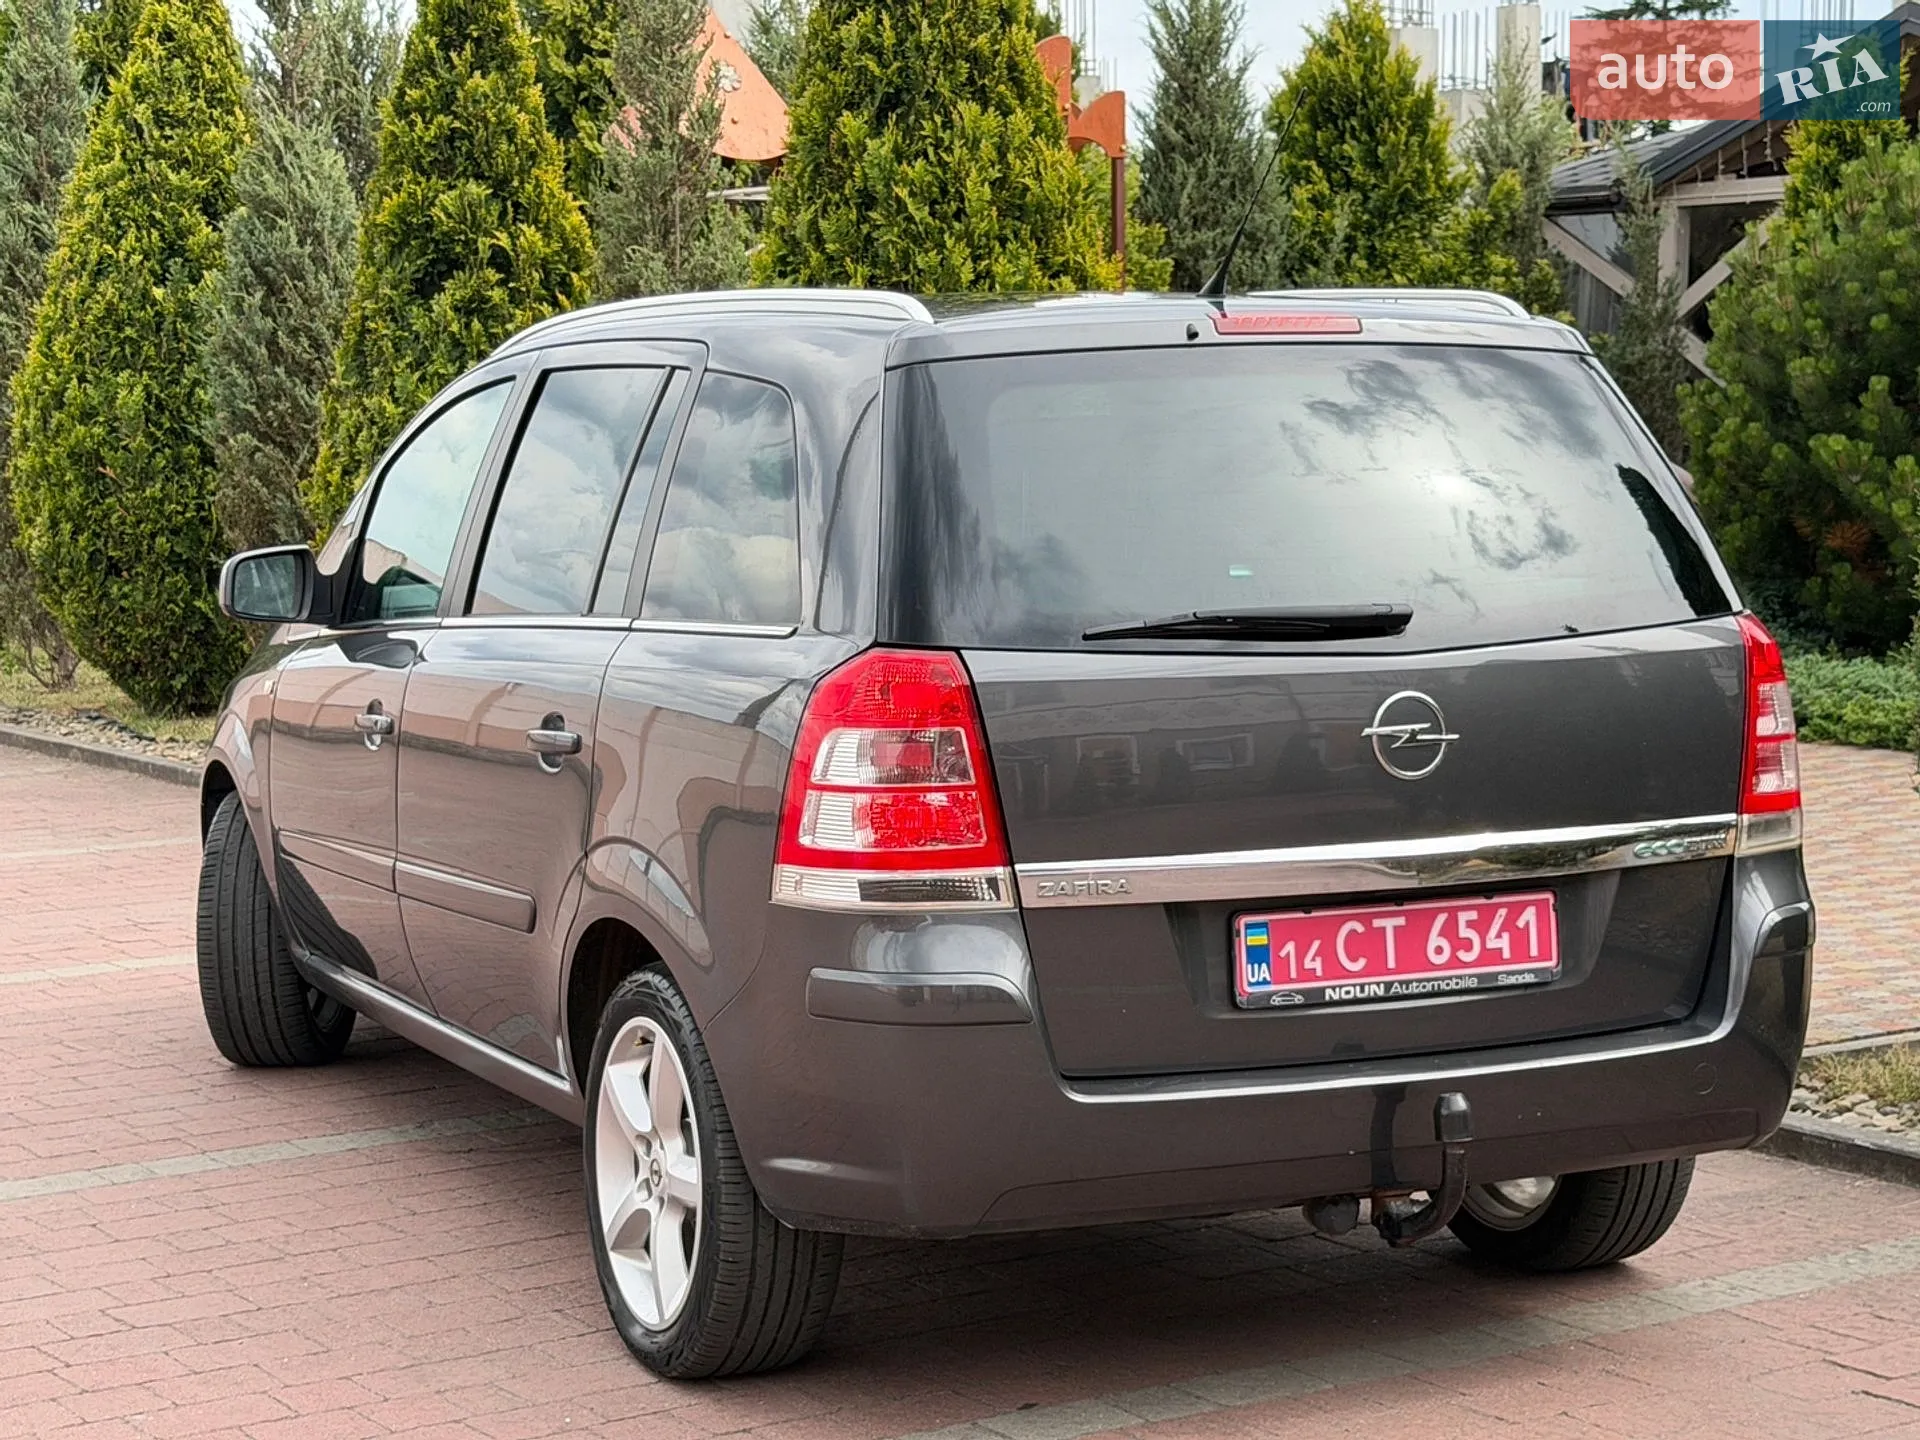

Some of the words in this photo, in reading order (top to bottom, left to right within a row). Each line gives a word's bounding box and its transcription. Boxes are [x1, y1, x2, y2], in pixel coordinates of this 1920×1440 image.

[1037, 878, 1132, 898] ZAFIRA
[1278, 939, 1323, 980] 14
[1335, 915, 1407, 973] CT
[1426, 904, 1540, 966] 6541
[1248, 962, 1272, 983] UA
[1324, 982, 1385, 1002] NOUN
[1390, 974, 1478, 995] Automobile
